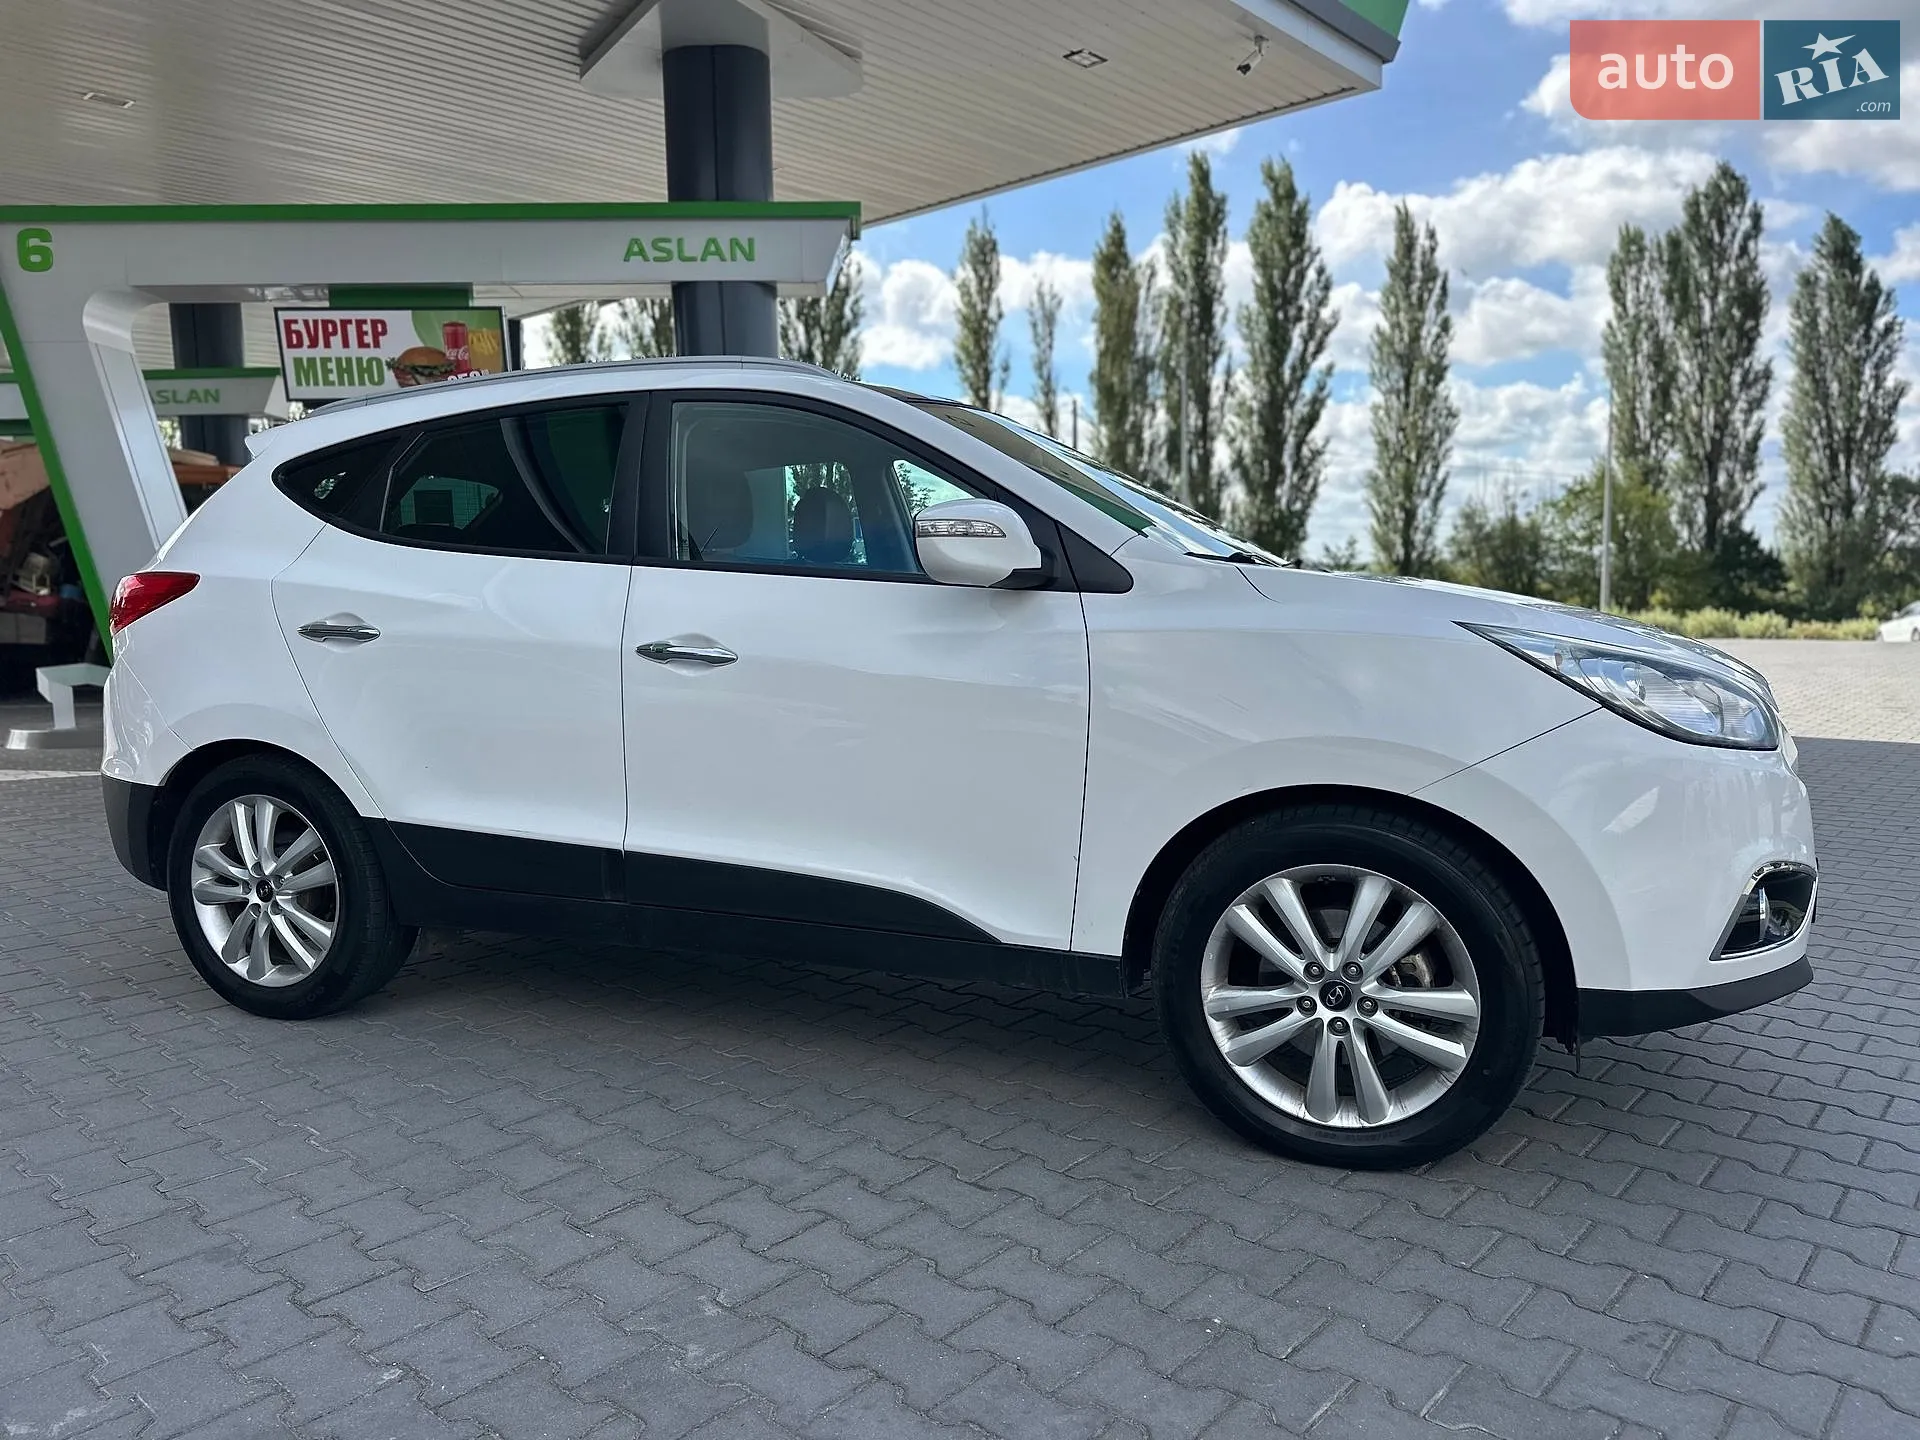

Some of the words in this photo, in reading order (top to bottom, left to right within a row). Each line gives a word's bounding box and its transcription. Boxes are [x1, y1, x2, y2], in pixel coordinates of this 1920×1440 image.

[17, 228, 54, 273] 6
[623, 237, 756, 263] ASLAN
[283, 318, 388, 350] БУРГЕР
[293, 356, 386, 387] МЕНЮ
